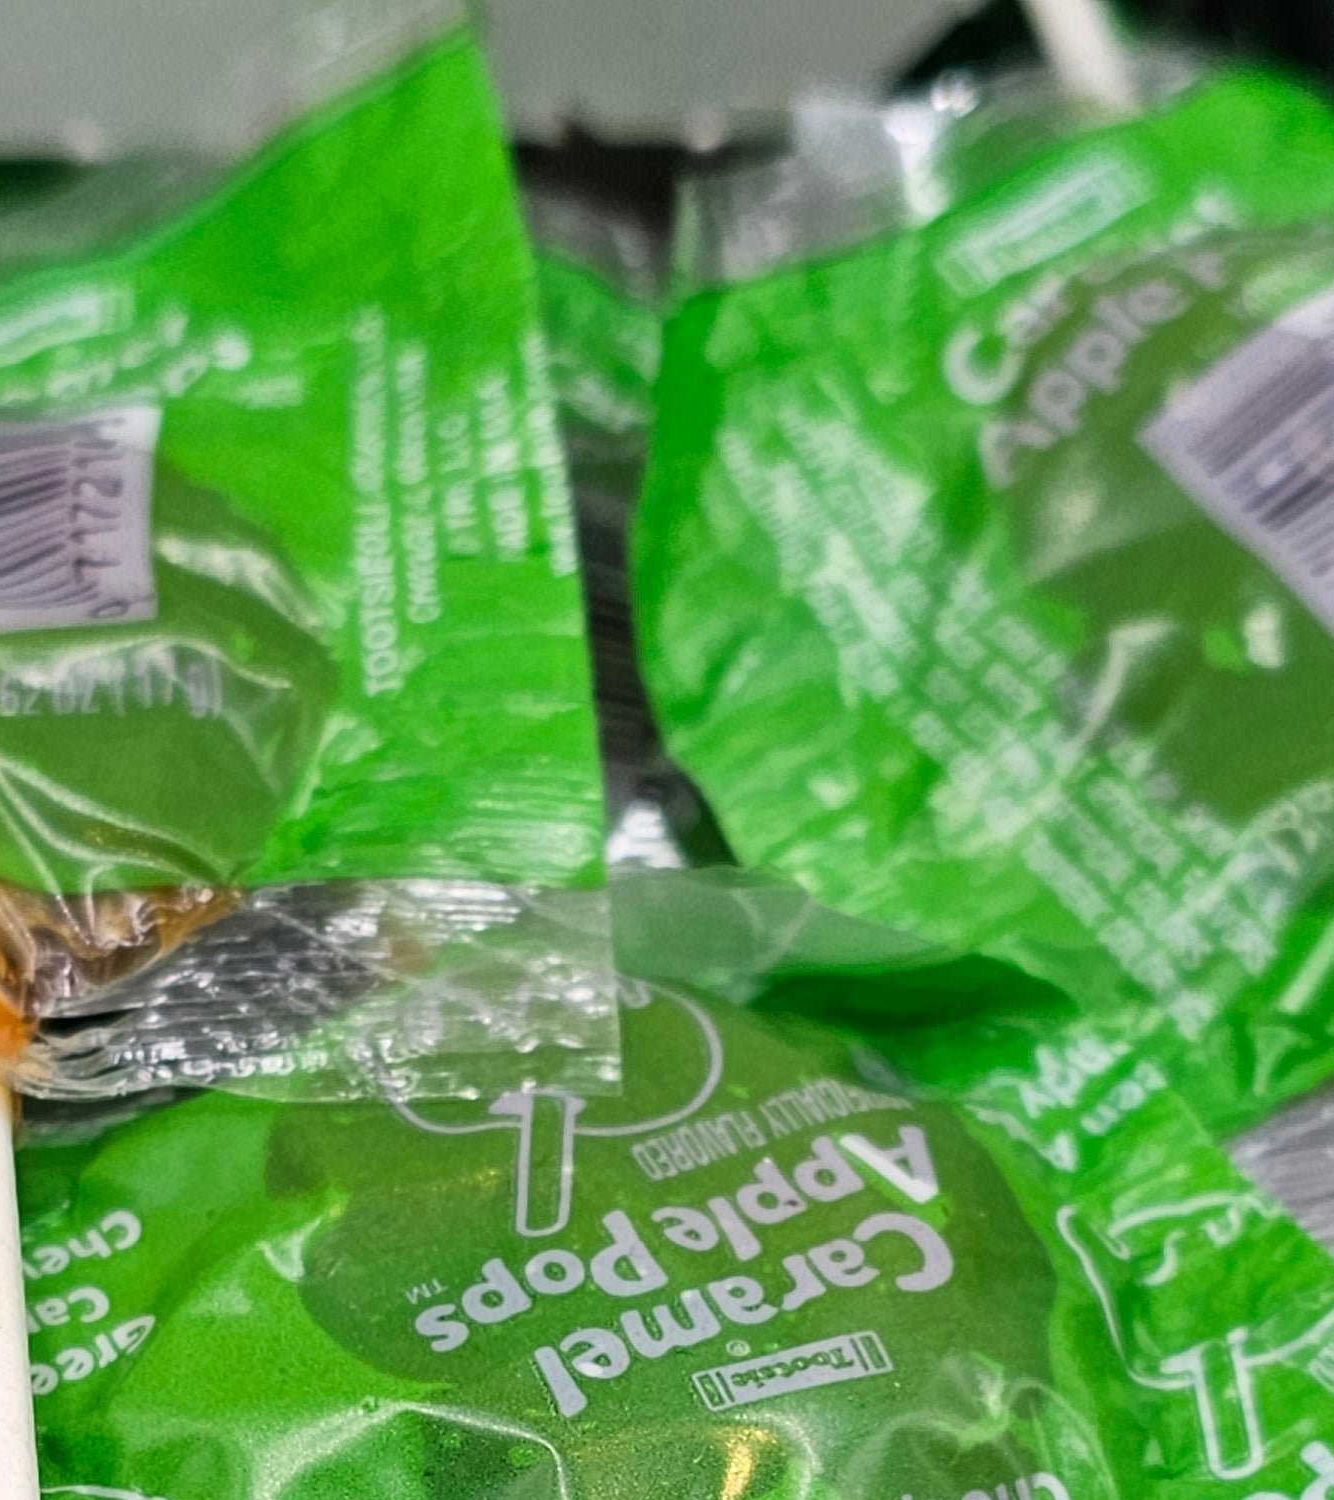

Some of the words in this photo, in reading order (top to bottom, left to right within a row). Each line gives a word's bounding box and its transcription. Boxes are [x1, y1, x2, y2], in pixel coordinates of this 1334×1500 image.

[631, 1117, 761, 1181] FLAVORED
[651, 1125, 939, 1262] Apple
[414, 1210, 668, 1353] Pops
[533, 1212, 954, 1418] Caramel
[30, 1314, 156, 1396] Gree
[732, 1345, 857, 1390] Tootsie
